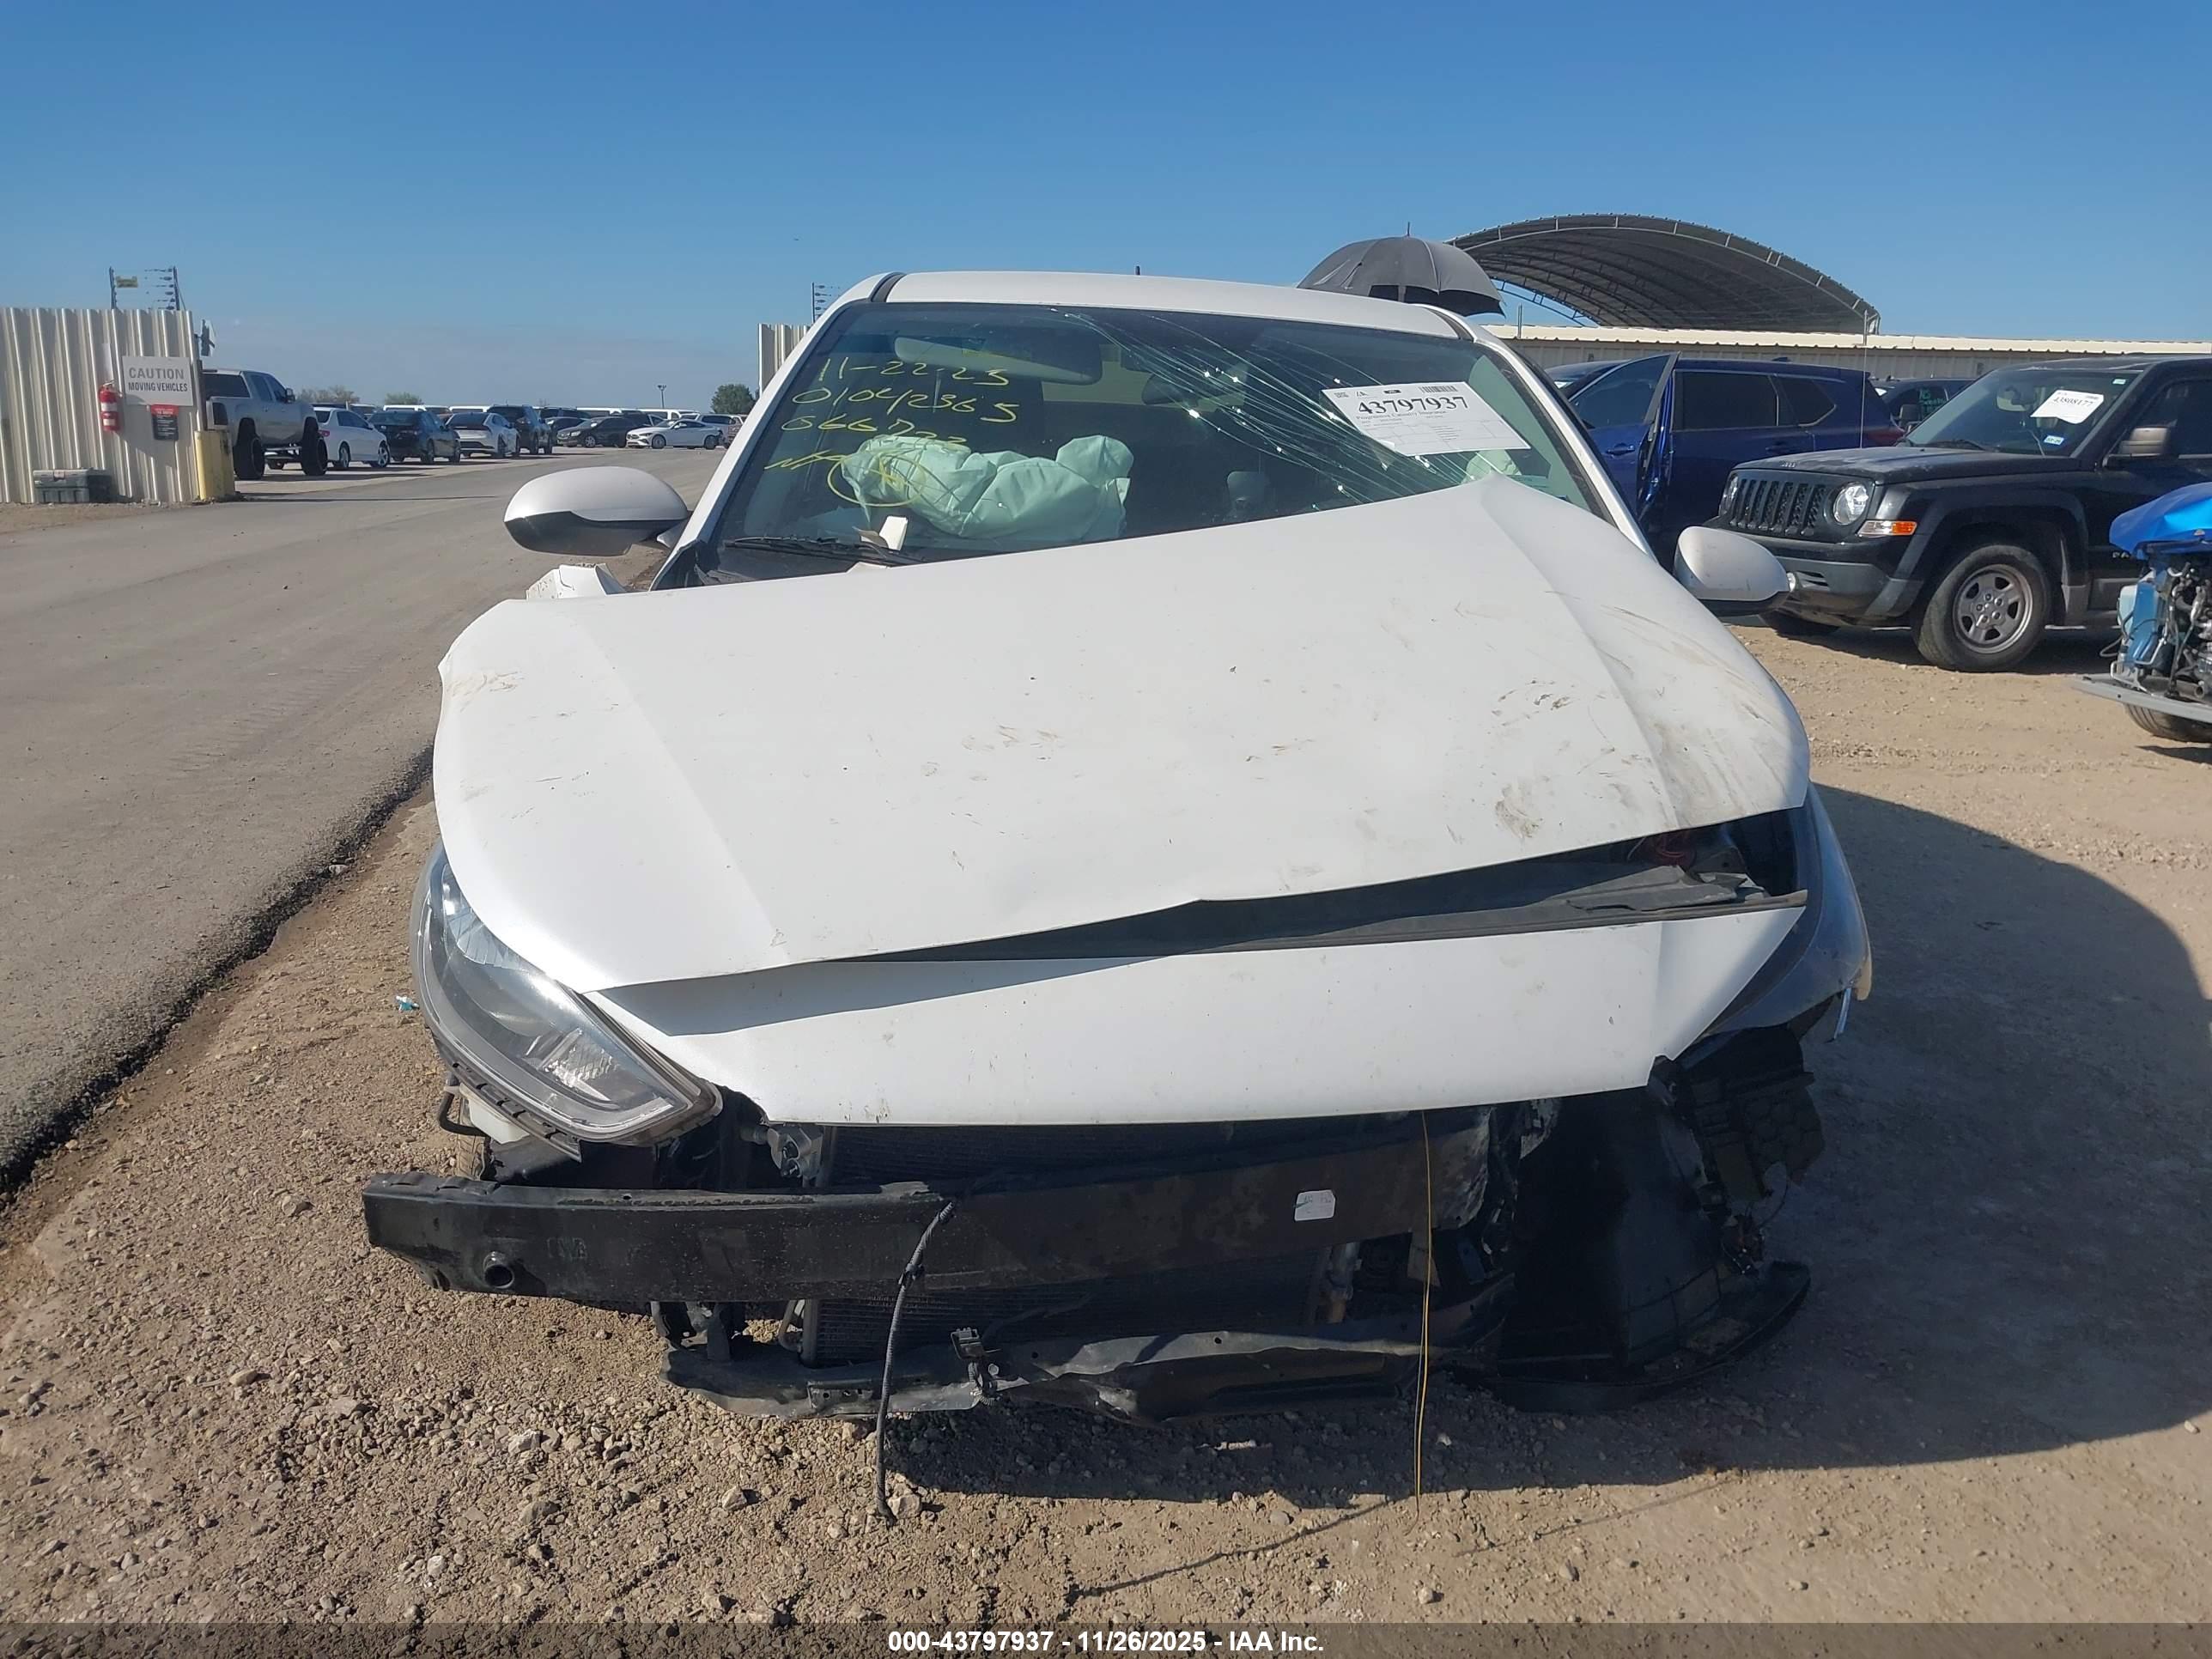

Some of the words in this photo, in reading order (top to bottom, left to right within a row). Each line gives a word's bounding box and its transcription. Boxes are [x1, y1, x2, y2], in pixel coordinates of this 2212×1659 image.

[129, 367, 184, 379] CAUTION
[128, 381, 155, 392] MOVING
[156, 382, 188, 392] VEHICLES
[1358, 396, 1468, 414] 43797937
